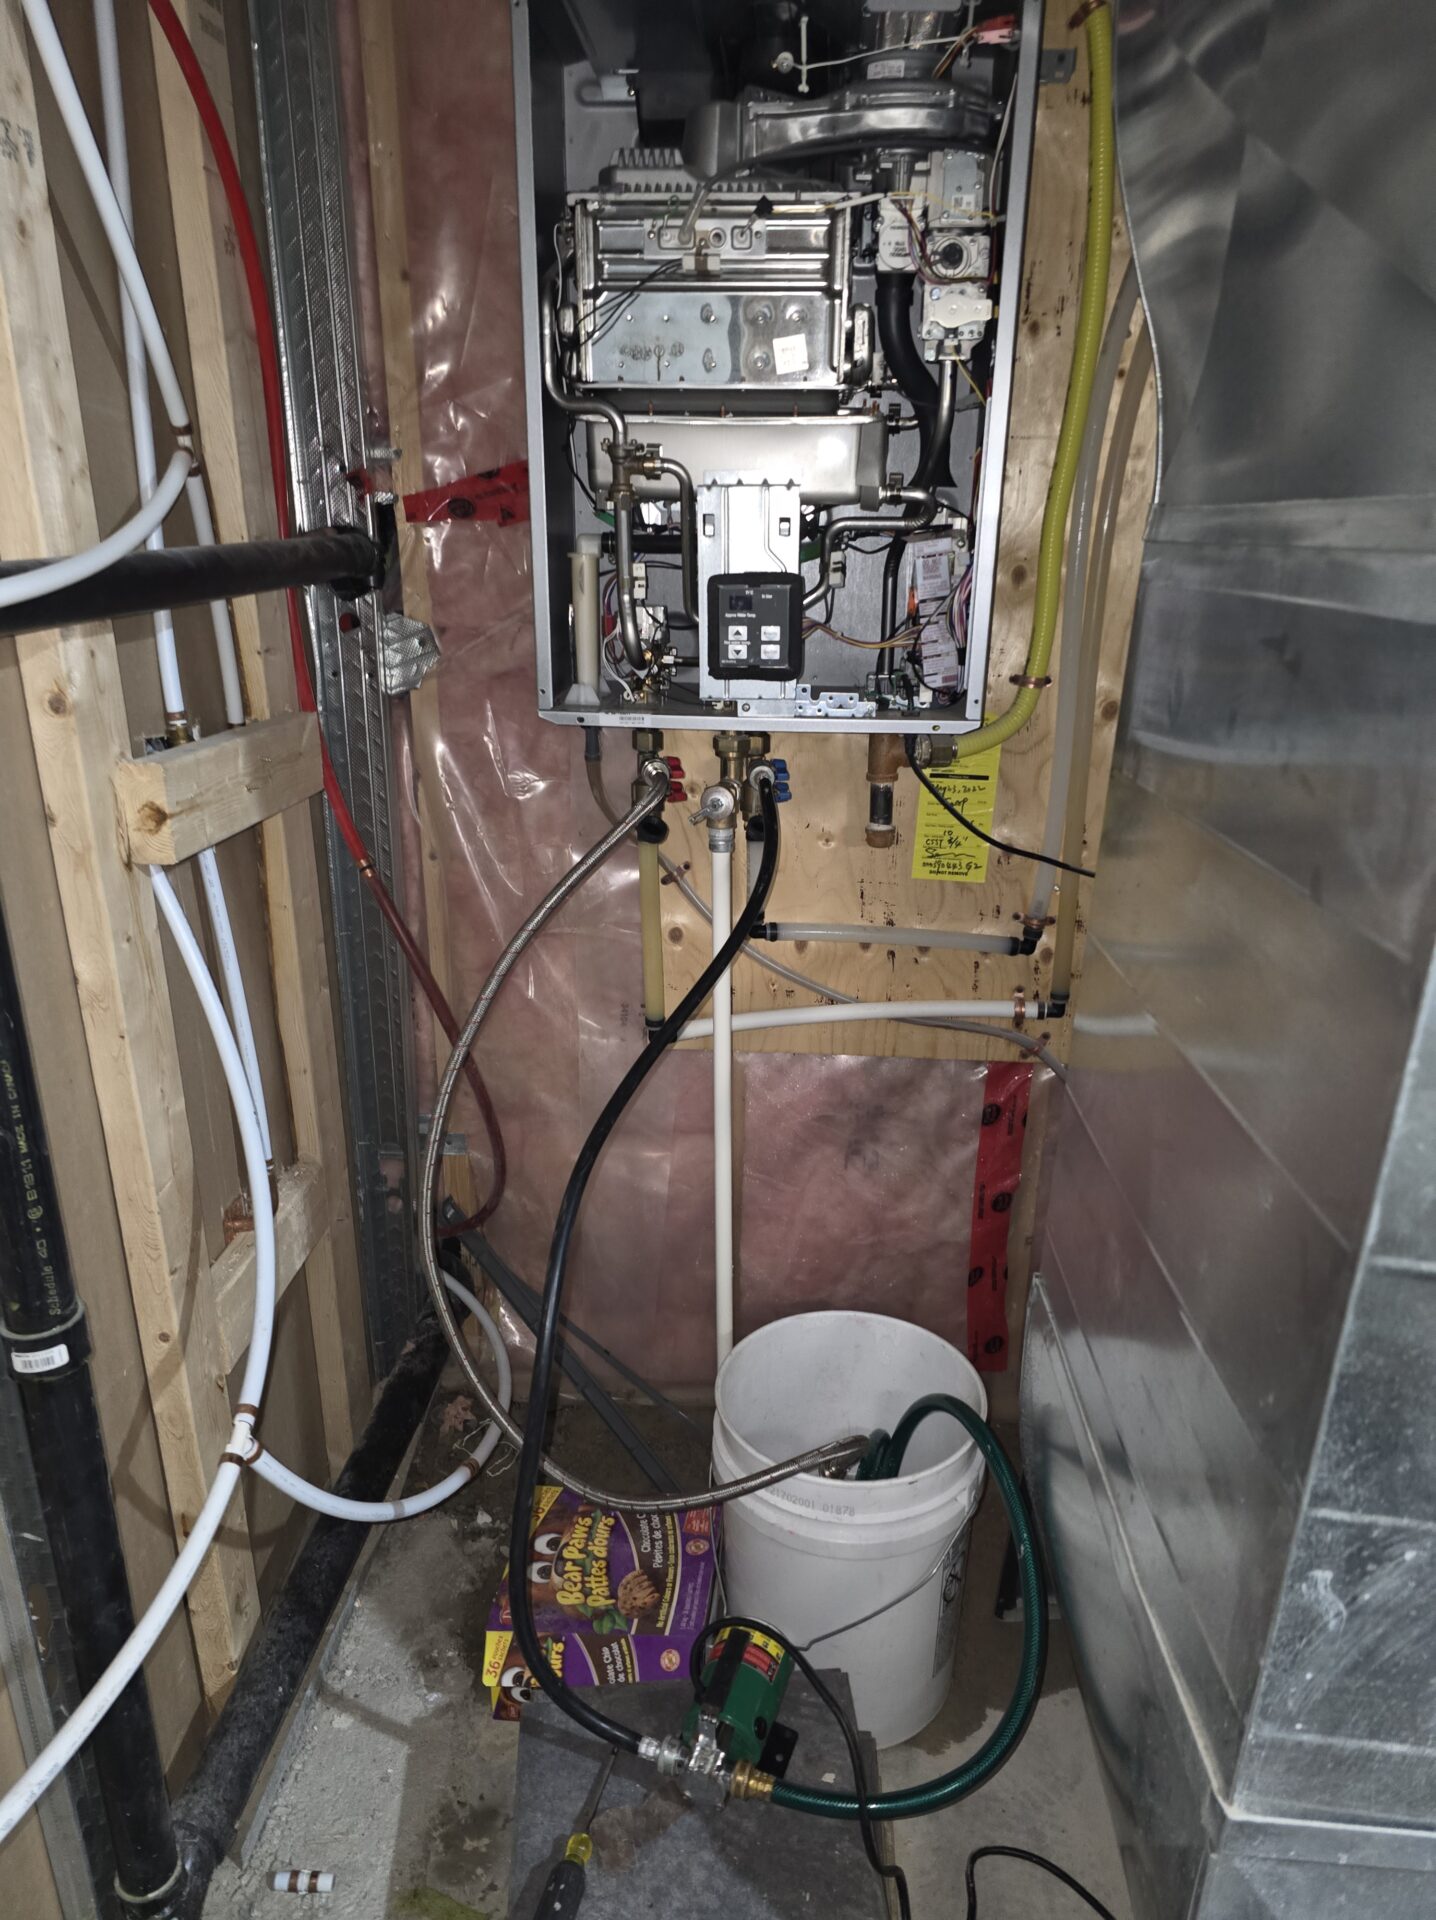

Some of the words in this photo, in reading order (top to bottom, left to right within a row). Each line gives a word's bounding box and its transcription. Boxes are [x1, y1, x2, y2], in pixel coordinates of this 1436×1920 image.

[41, 1265, 61, 1315] Schedule
[562, 1516, 592, 1563] Paws
[639, 1519, 651, 1553] Chocolate
[652, 1540, 663, 1568] Pépites
[556, 1564, 585, 1606] Bear
[586, 1560, 616, 1607] Pattes
[485, 1661, 501, 1679] 36
[610, 1641, 624, 1671] chocolat
